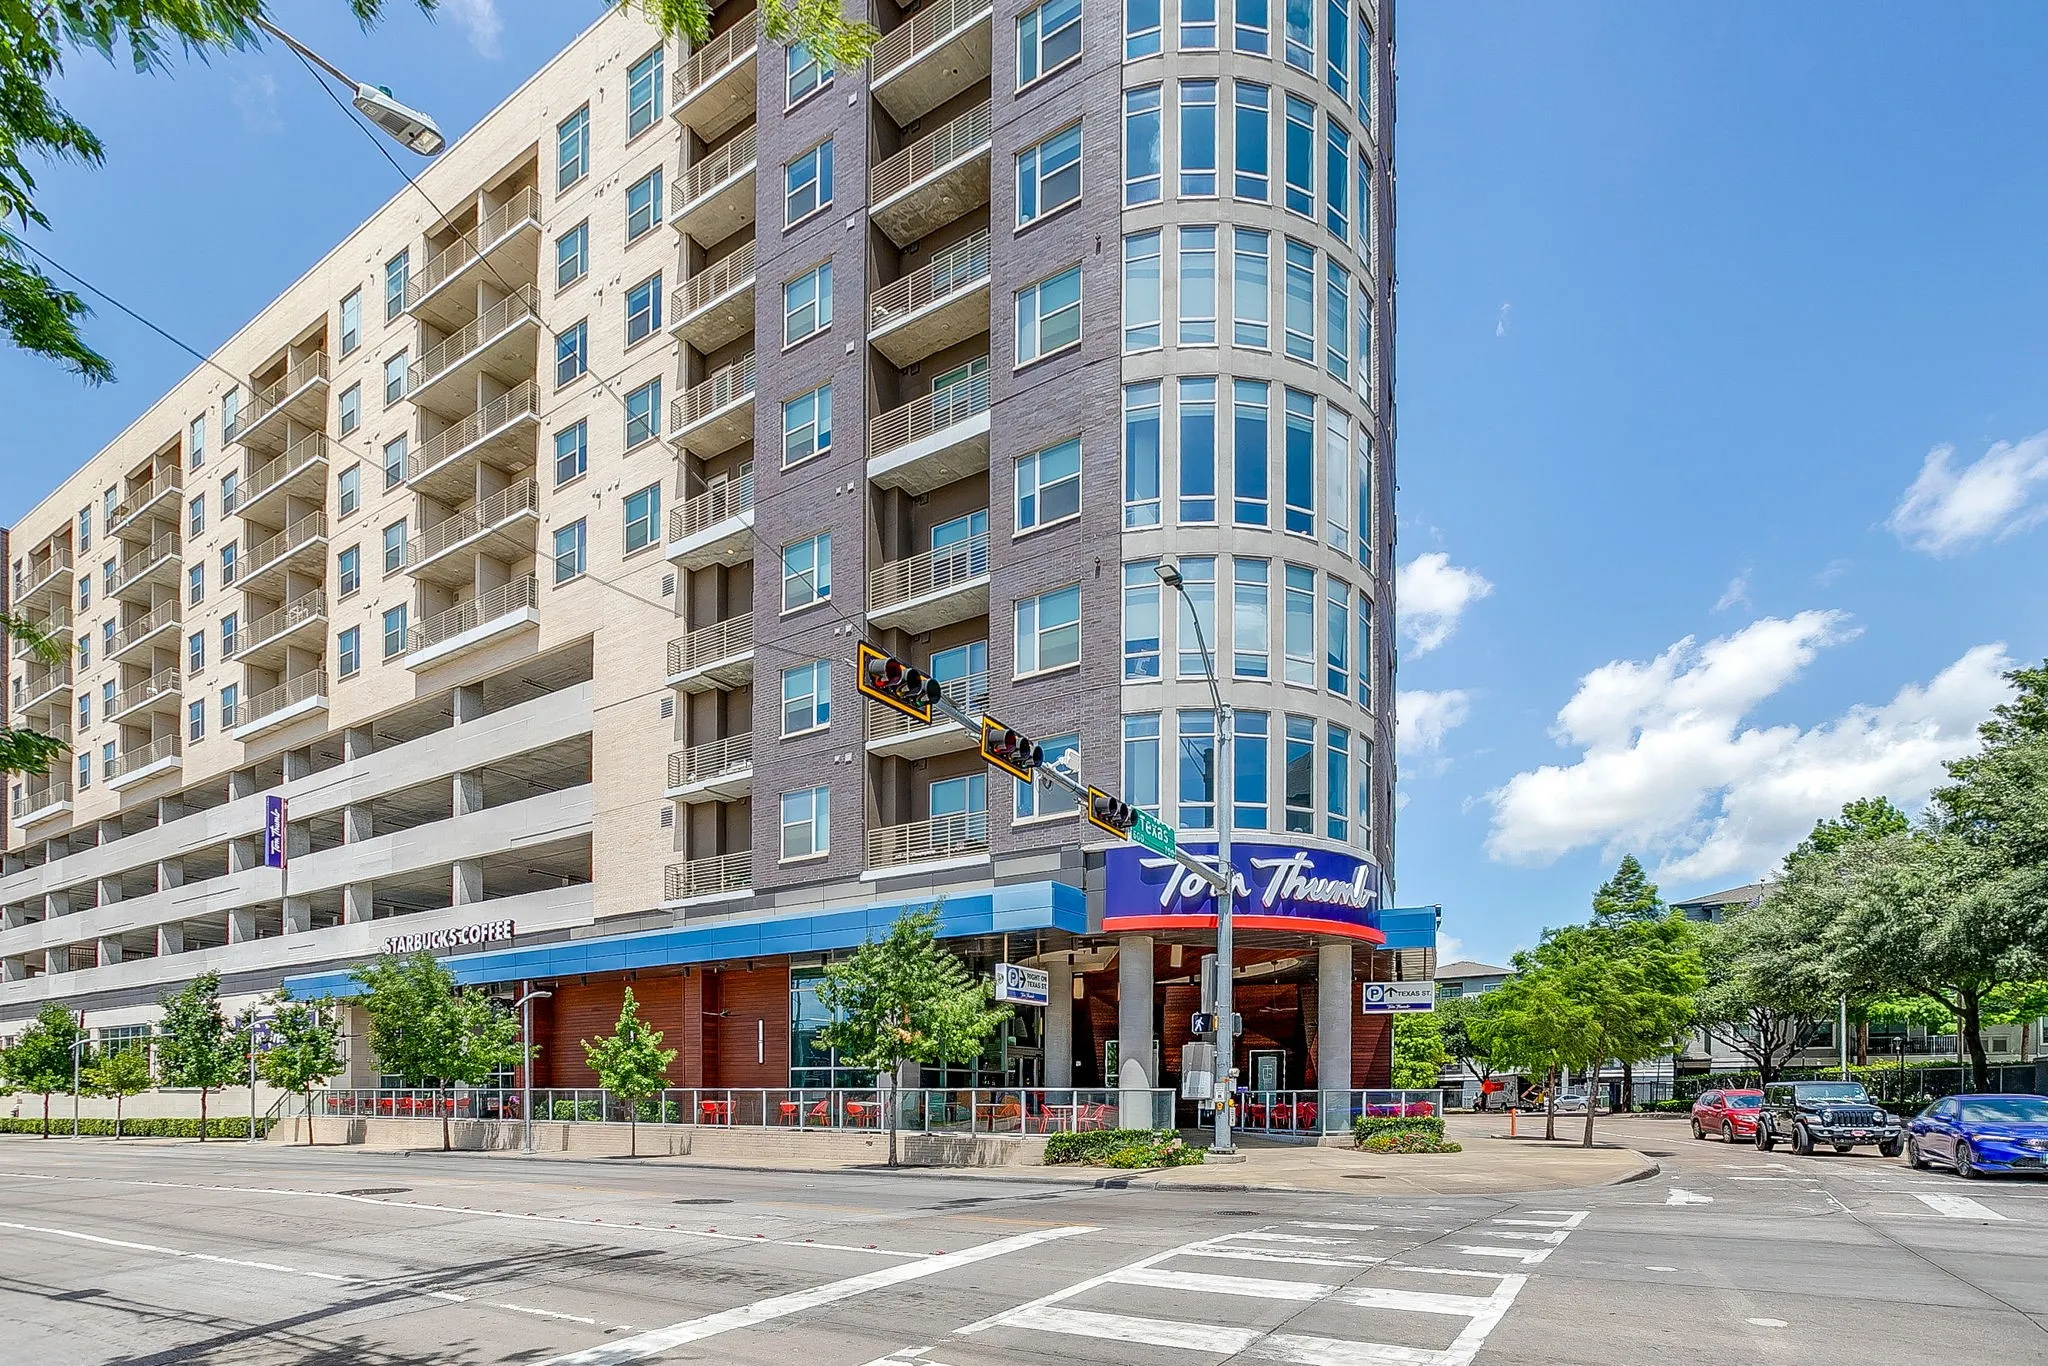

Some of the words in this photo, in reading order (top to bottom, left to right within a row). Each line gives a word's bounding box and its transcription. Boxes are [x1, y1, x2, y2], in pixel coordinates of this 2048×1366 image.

[269, 808, 282, 837] Thumb
[1139, 815, 1169, 844] Texas
[270, 838, 282, 855] Tom
[1250, 851, 1377, 909] Thumb
[384, 928, 458, 955] STARBUCKS
[460, 919, 514, 945] COFFEE
[1026, 973, 1040, 981] RIGHT
[1027, 980, 1041, 989] TEXAS
